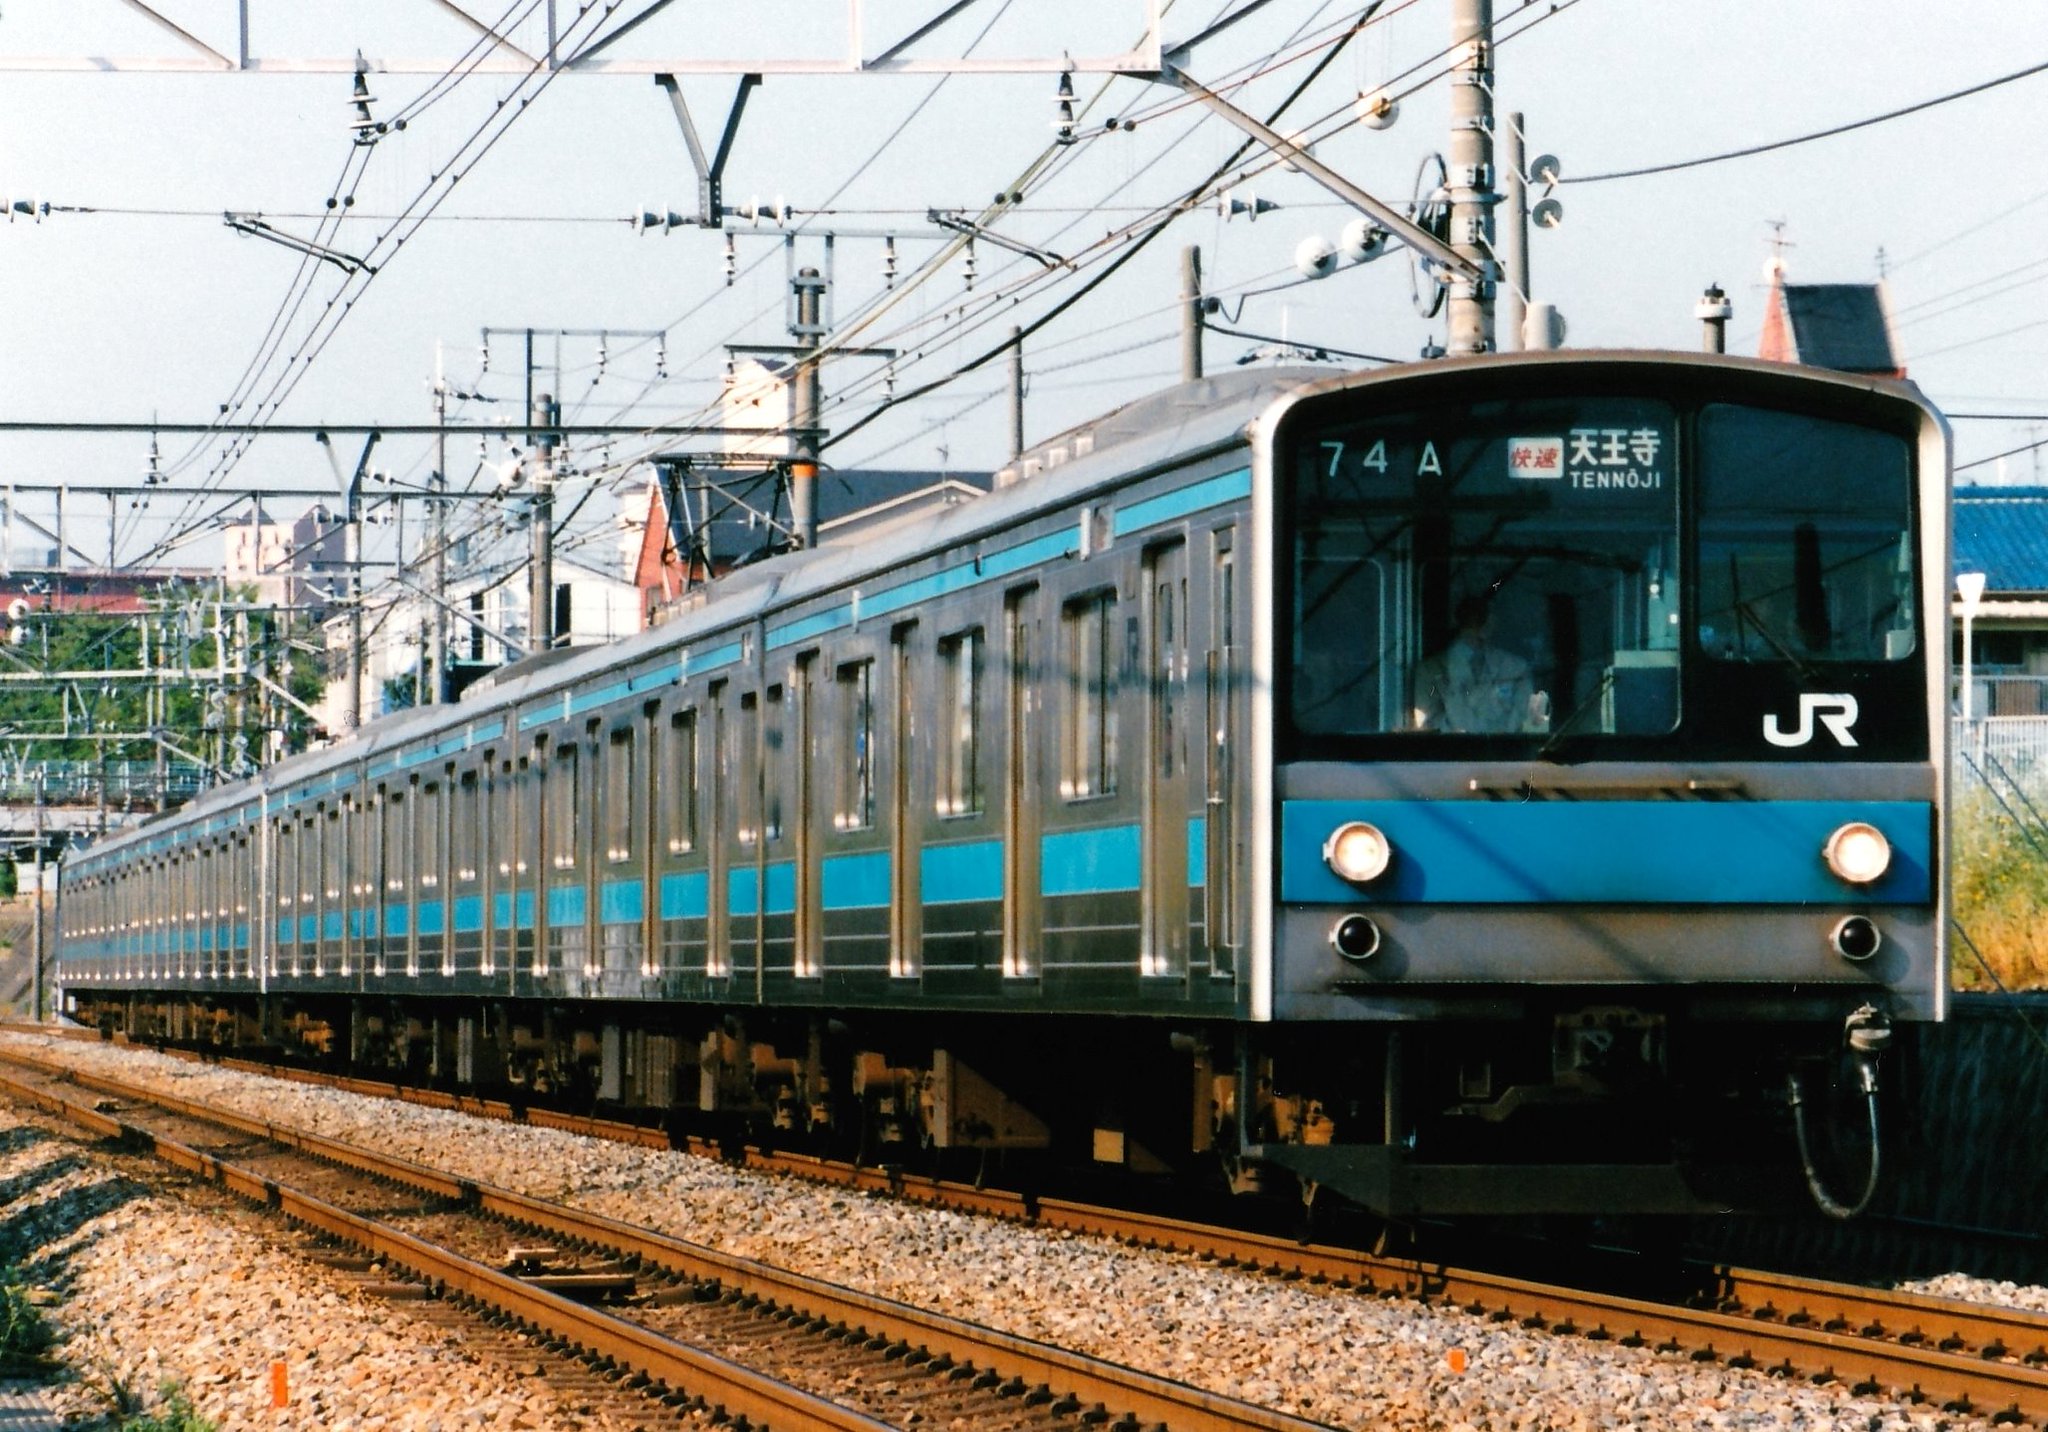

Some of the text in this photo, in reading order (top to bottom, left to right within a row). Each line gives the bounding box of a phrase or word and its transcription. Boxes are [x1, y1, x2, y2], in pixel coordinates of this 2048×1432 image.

[1510, 446, 1559, 469] 快速
[1569, 427, 1661, 466] 天王寺
[1763, 693, 1859, 747] JR
